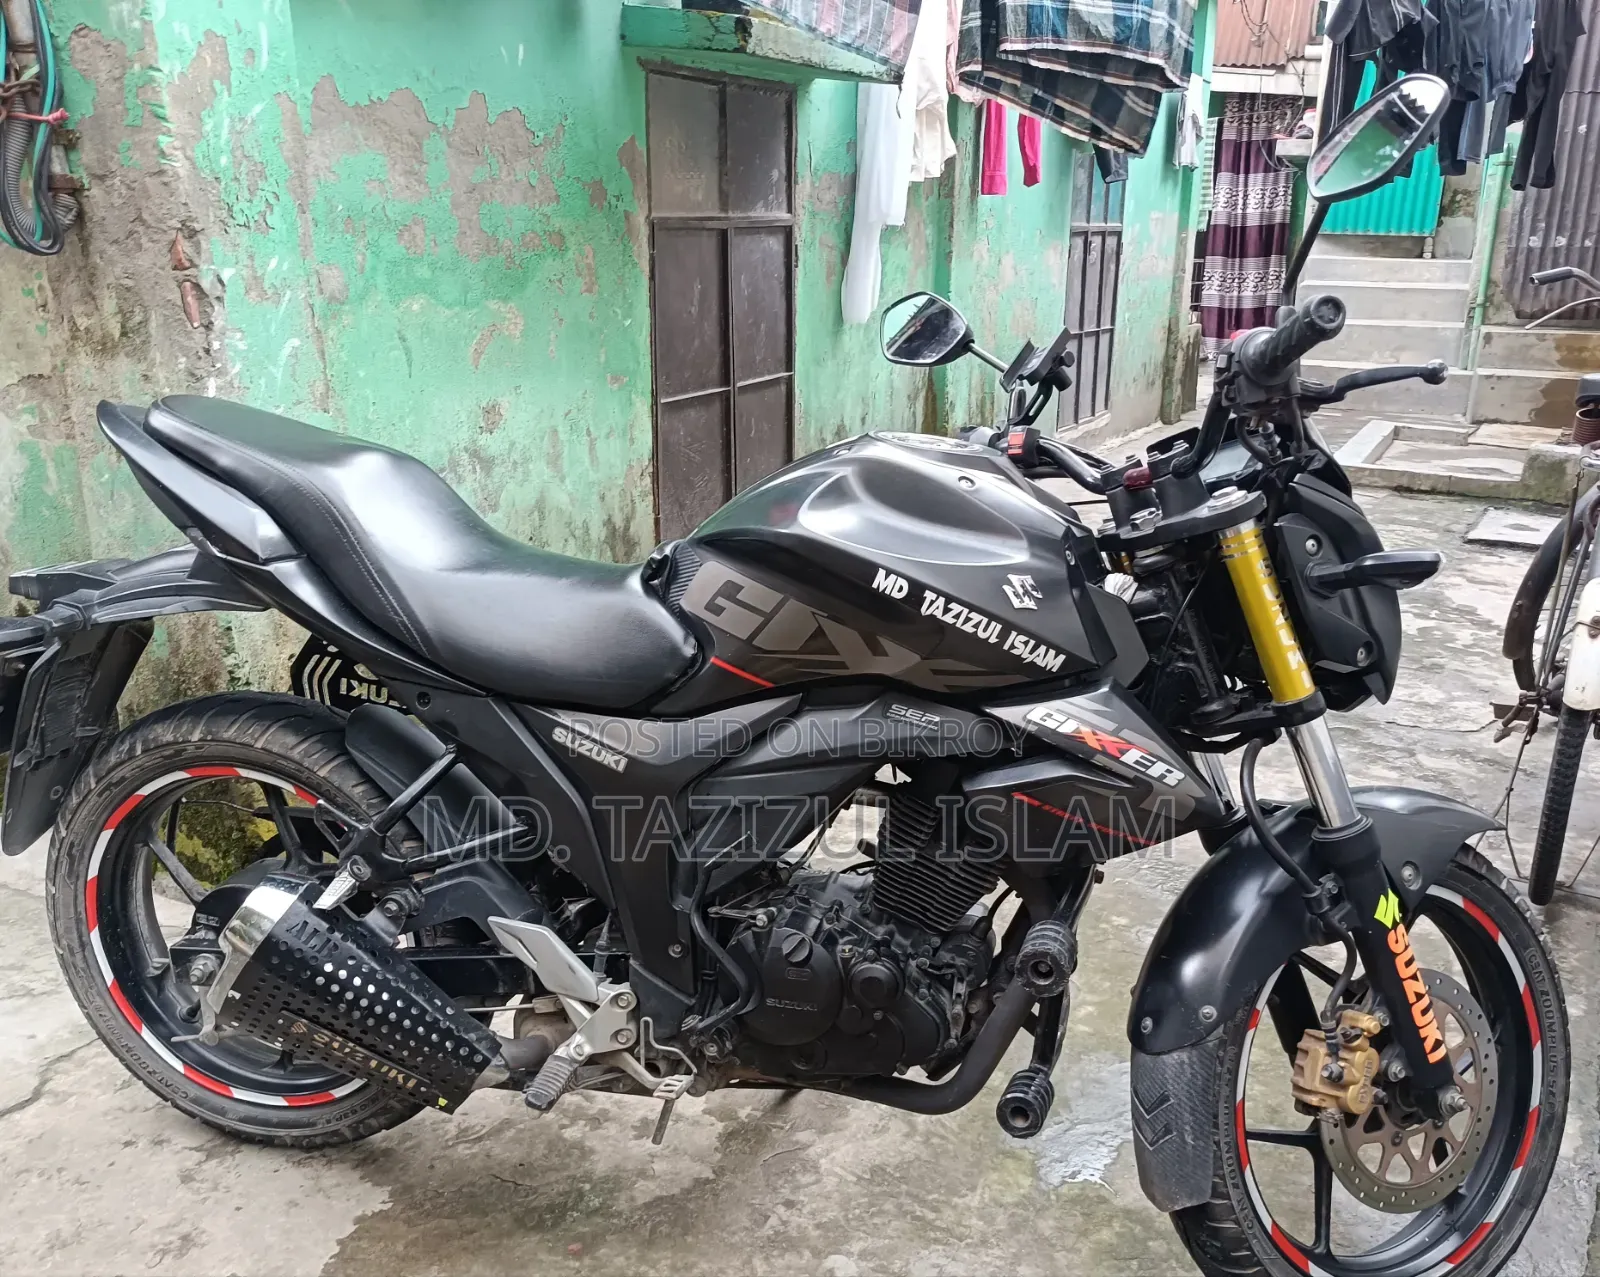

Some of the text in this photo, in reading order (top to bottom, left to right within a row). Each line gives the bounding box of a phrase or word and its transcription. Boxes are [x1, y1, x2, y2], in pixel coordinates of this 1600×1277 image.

[871, 568, 1067, 673] MD TAZIZUL ISLAM
[552, 726, 628, 774] SUZUKI
[1026, 706, 1186, 788] GIXXER
[765, 997, 818, 1011] SUZUKI
[1387, 923, 1448, 1065] SUZUKI
